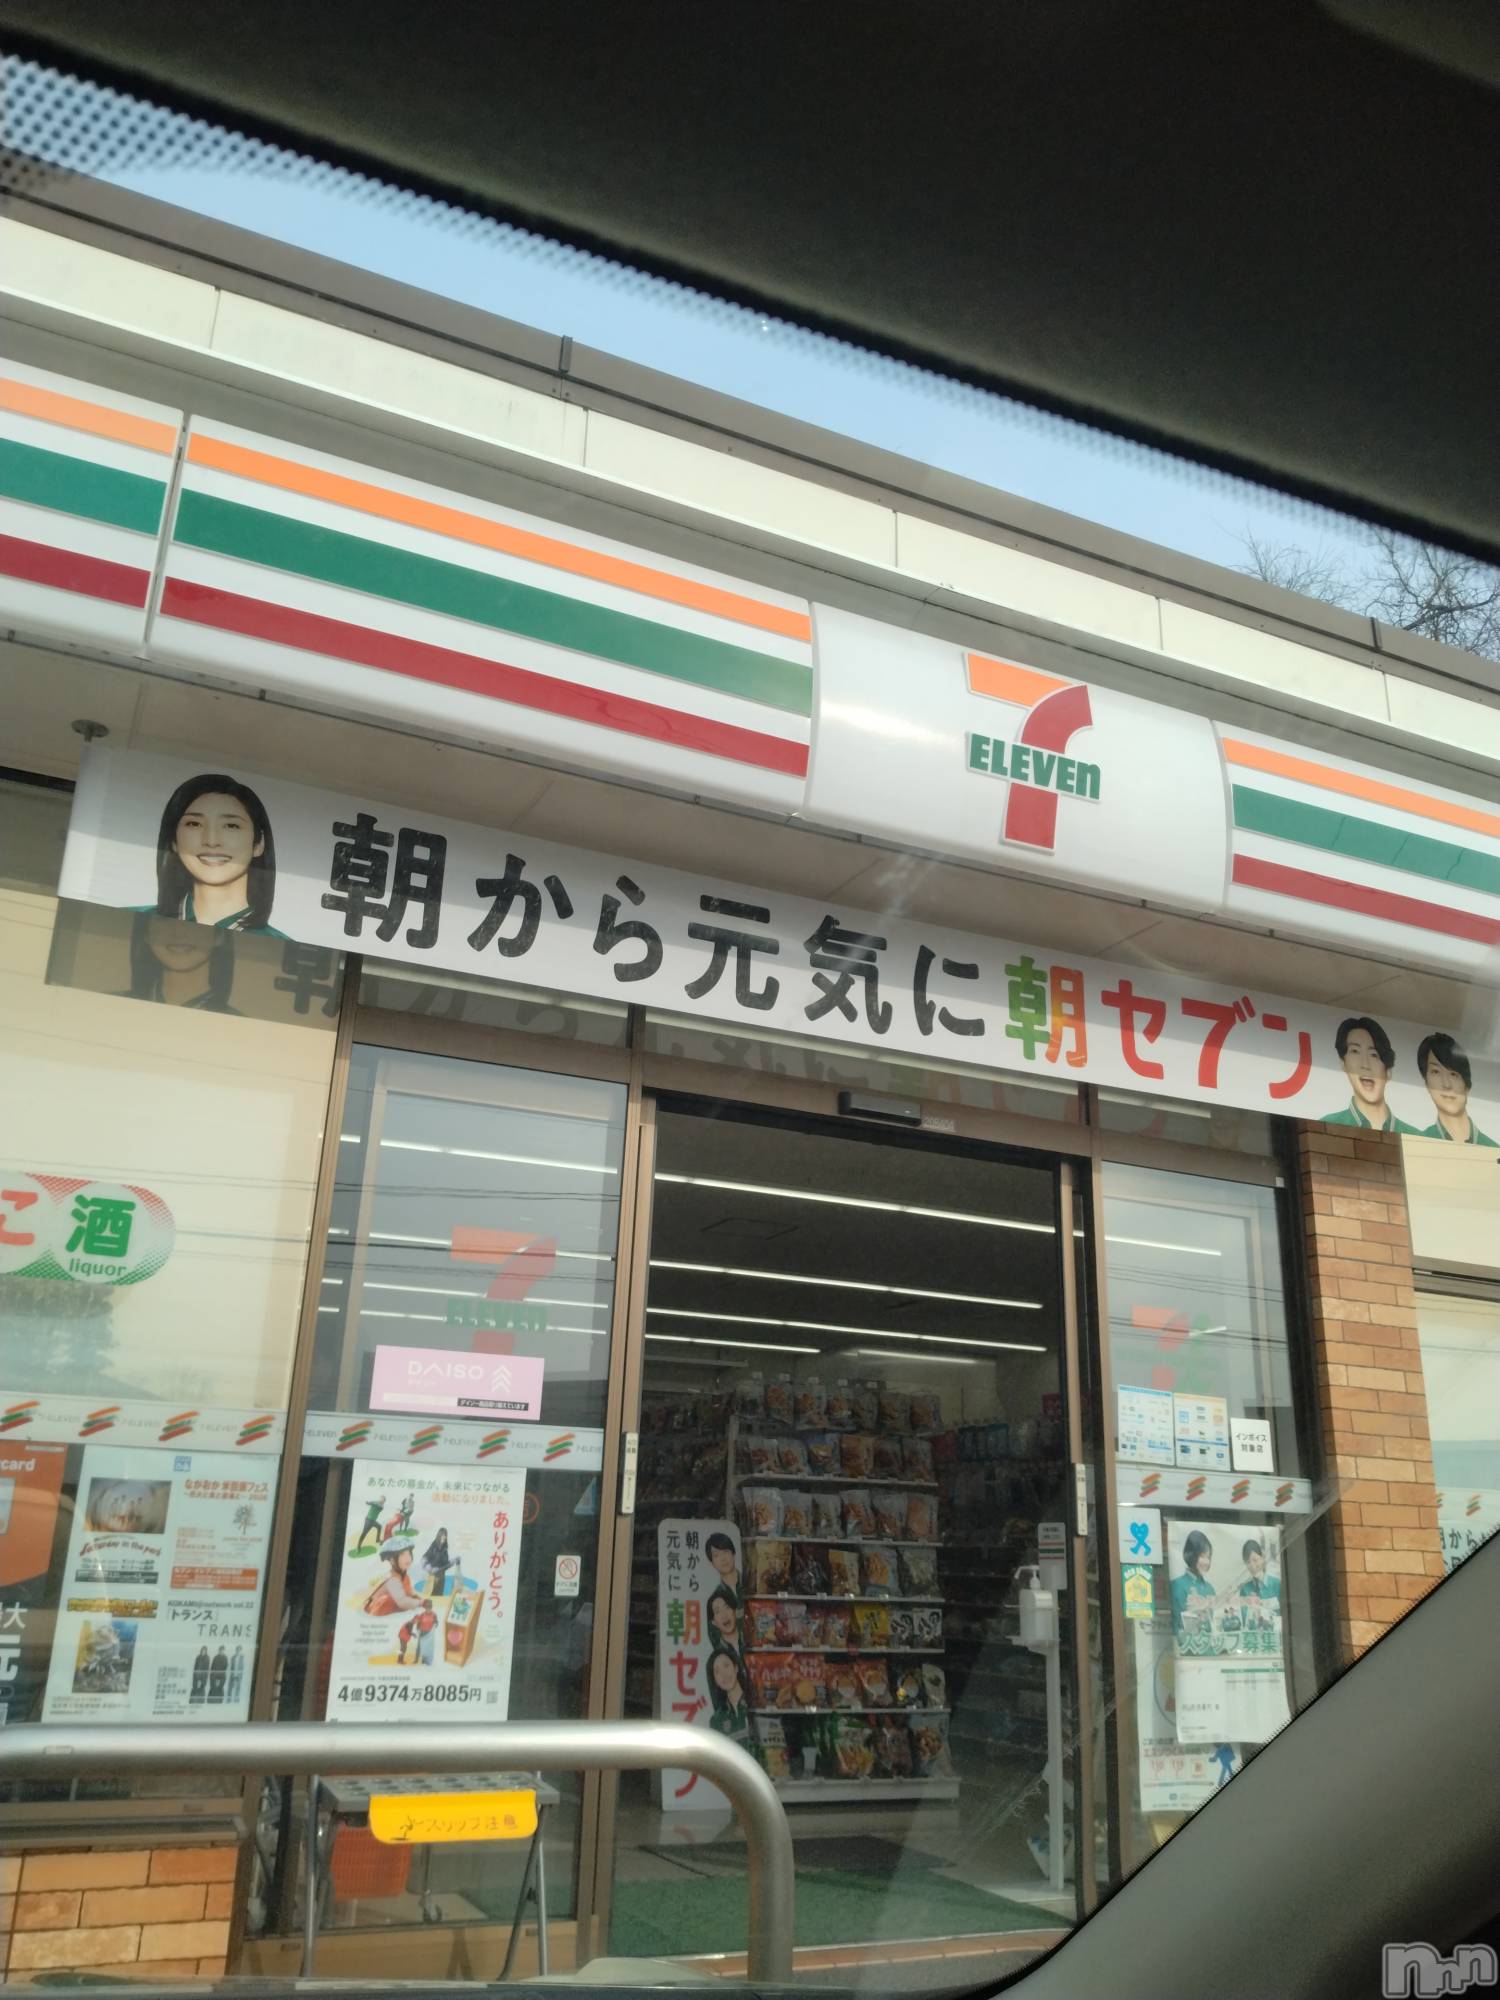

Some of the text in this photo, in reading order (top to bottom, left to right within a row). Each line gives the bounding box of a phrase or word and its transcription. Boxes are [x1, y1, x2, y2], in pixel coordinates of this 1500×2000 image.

[966, 652, 1094, 851] 7
[321, 812, 1312, 1099] 朝から元気に朝セブン
[65, 1194, 136, 1258] 酒
[69, 1258, 127, 1277] liquor
[408, 1361, 483, 1380] DAISO
[1235, 1432, 1268, 1442] インボイス
[488, 1511, 510, 1619] ありがとう。
[666, 1530, 682, 1592] 元気に
[685, 1530, 701, 1592] 朝から
[1179, 1631, 1279, 1656] スタッフ募集
[337, 1683, 482, 1703] 4億9374万8085円
